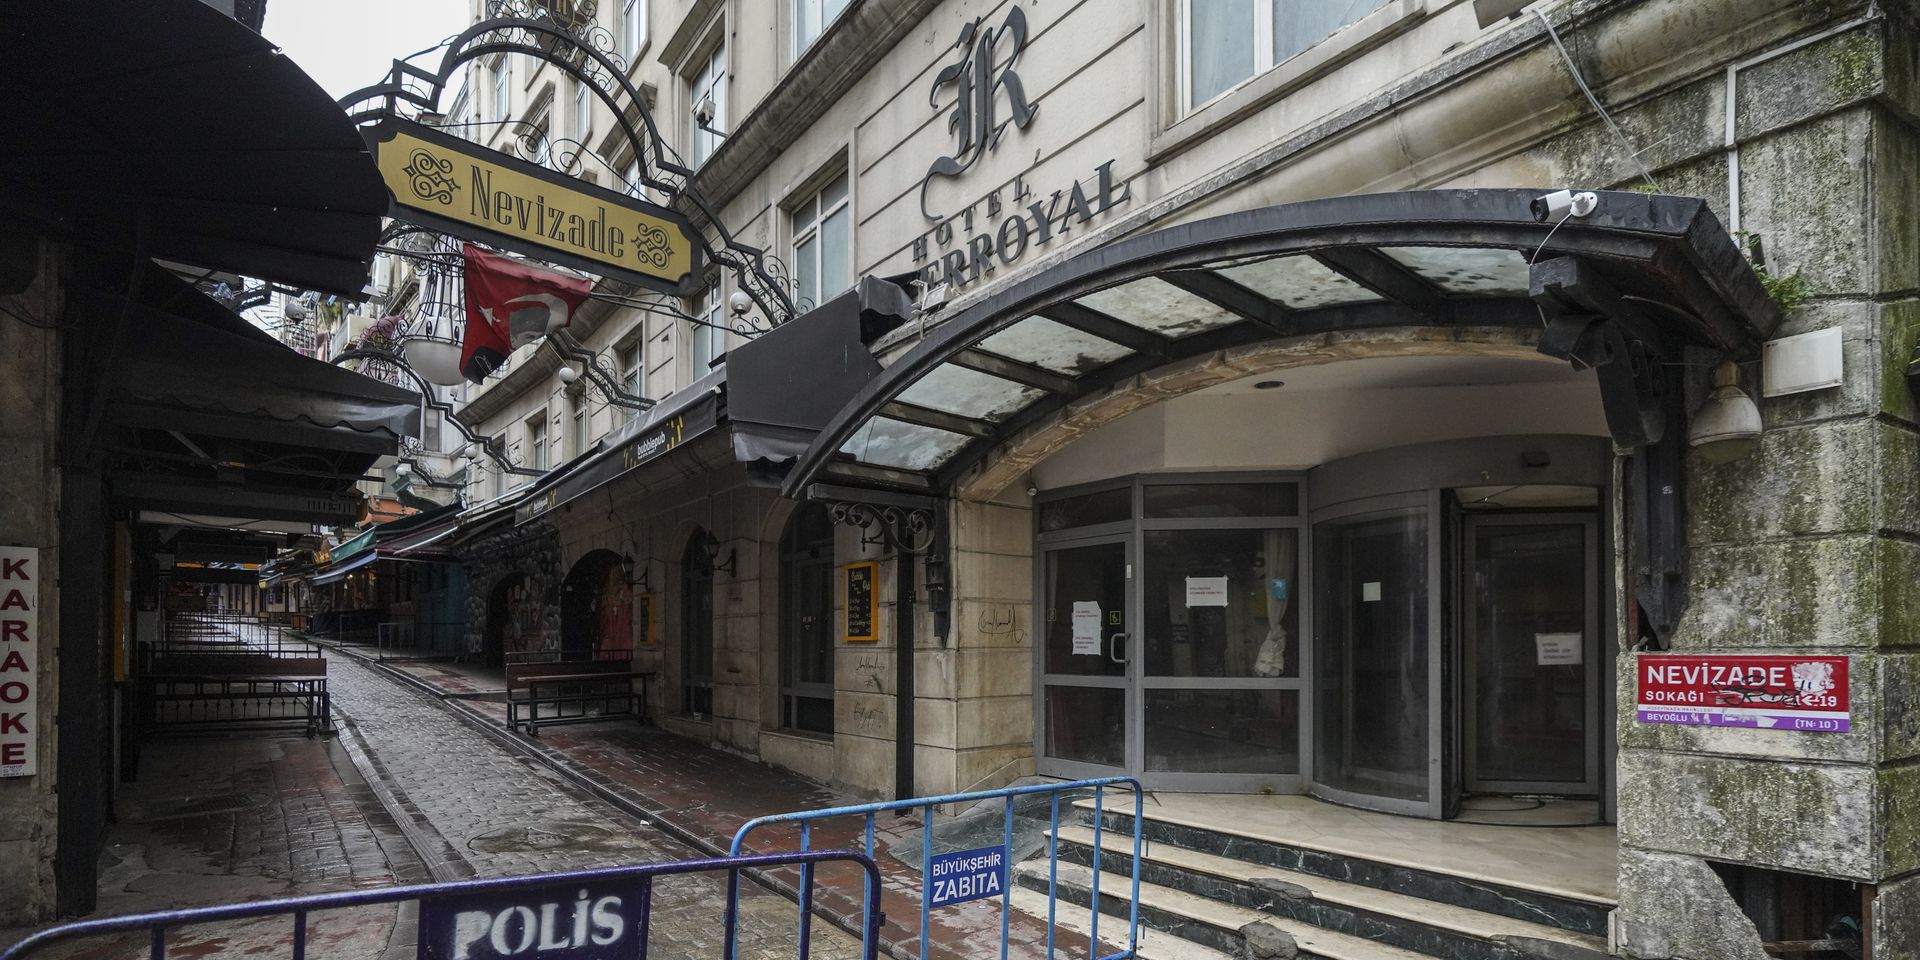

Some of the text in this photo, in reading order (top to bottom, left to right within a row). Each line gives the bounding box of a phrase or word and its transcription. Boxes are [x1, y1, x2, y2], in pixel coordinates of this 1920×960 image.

[470, 164, 624, 259] Nevizade
[911, 173, 1030, 263] HOTEL
[918, 158, 1131, 289] ERROYAL
[0, 558, 31, 766] KARAOKE
[1646, 662, 1787, 687] NEVİZADE
[1645, 689, 1704, 703] SOKAĞI
[1647, 713, 1688, 722] BEYOĞLU
[932, 851, 1001, 877] BÜYÜKŞEHİR
[932, 871, 1000, 903] ZABITA
[452, 888, 625, 960] POLİS
